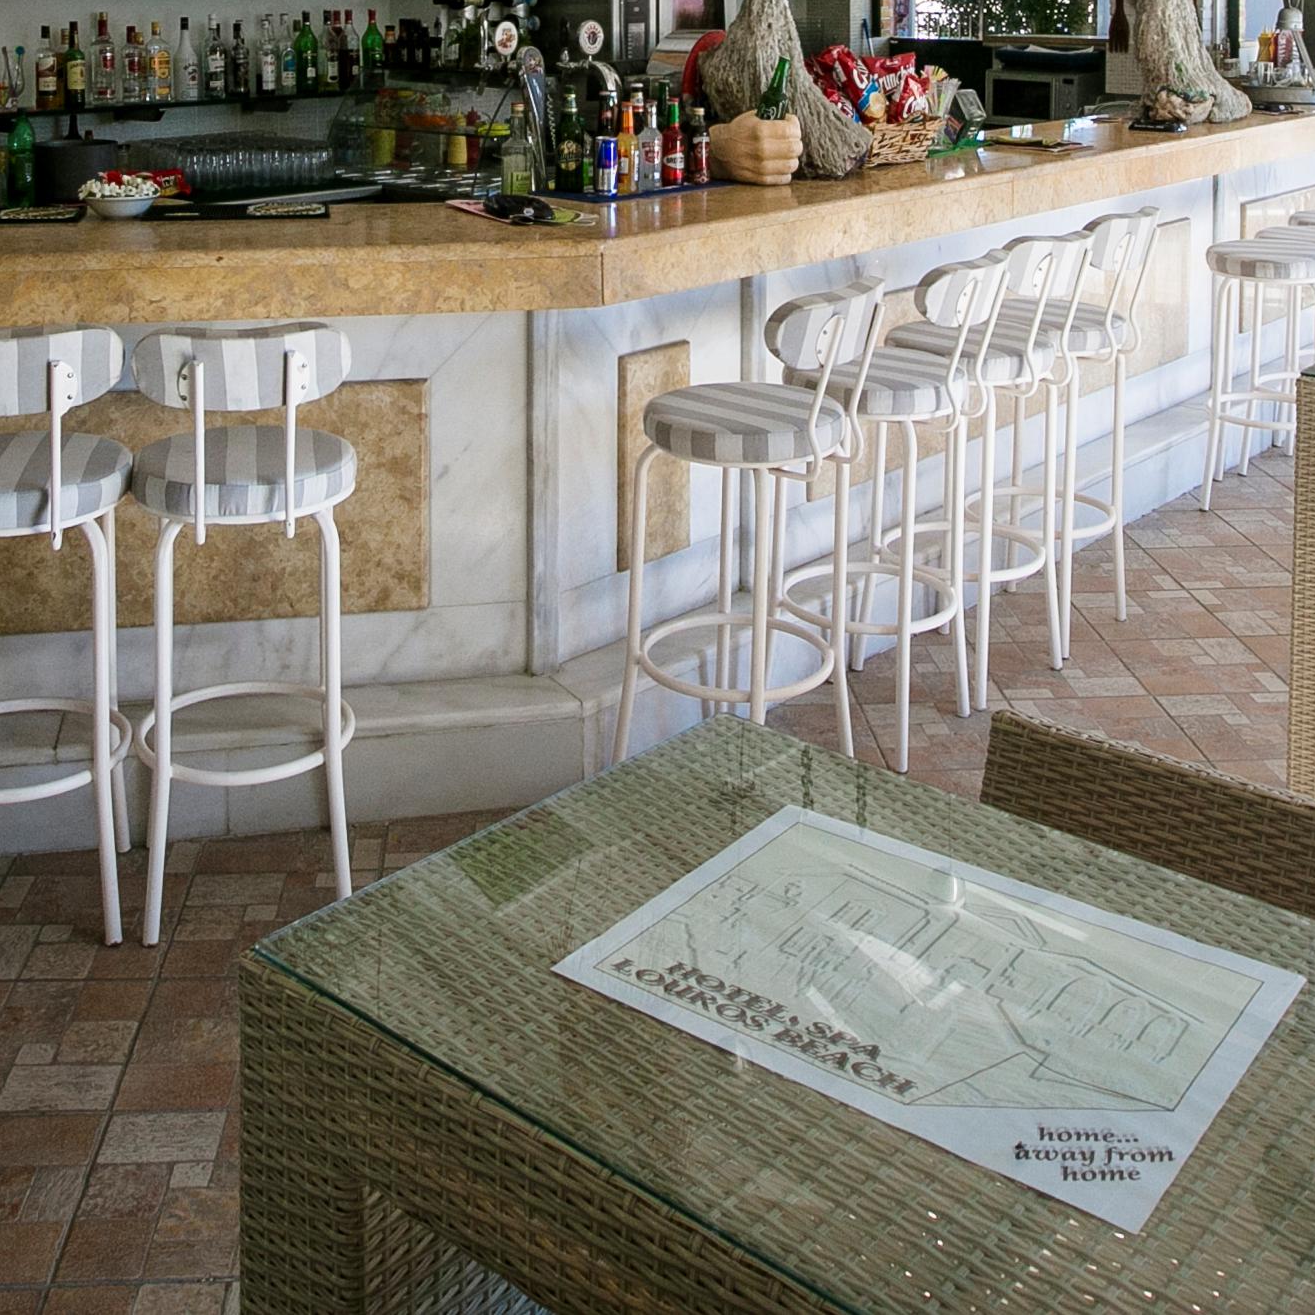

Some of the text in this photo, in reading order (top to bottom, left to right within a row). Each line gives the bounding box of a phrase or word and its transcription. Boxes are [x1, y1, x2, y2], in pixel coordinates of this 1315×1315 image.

[611, 957, 919, 1097] LOUROS BEACH
[664, 960, 882, 1064] HOTEL SPA
[1015, 1146, 1175, 1167] away from
[1061, 1165, 1142, 1182] home
